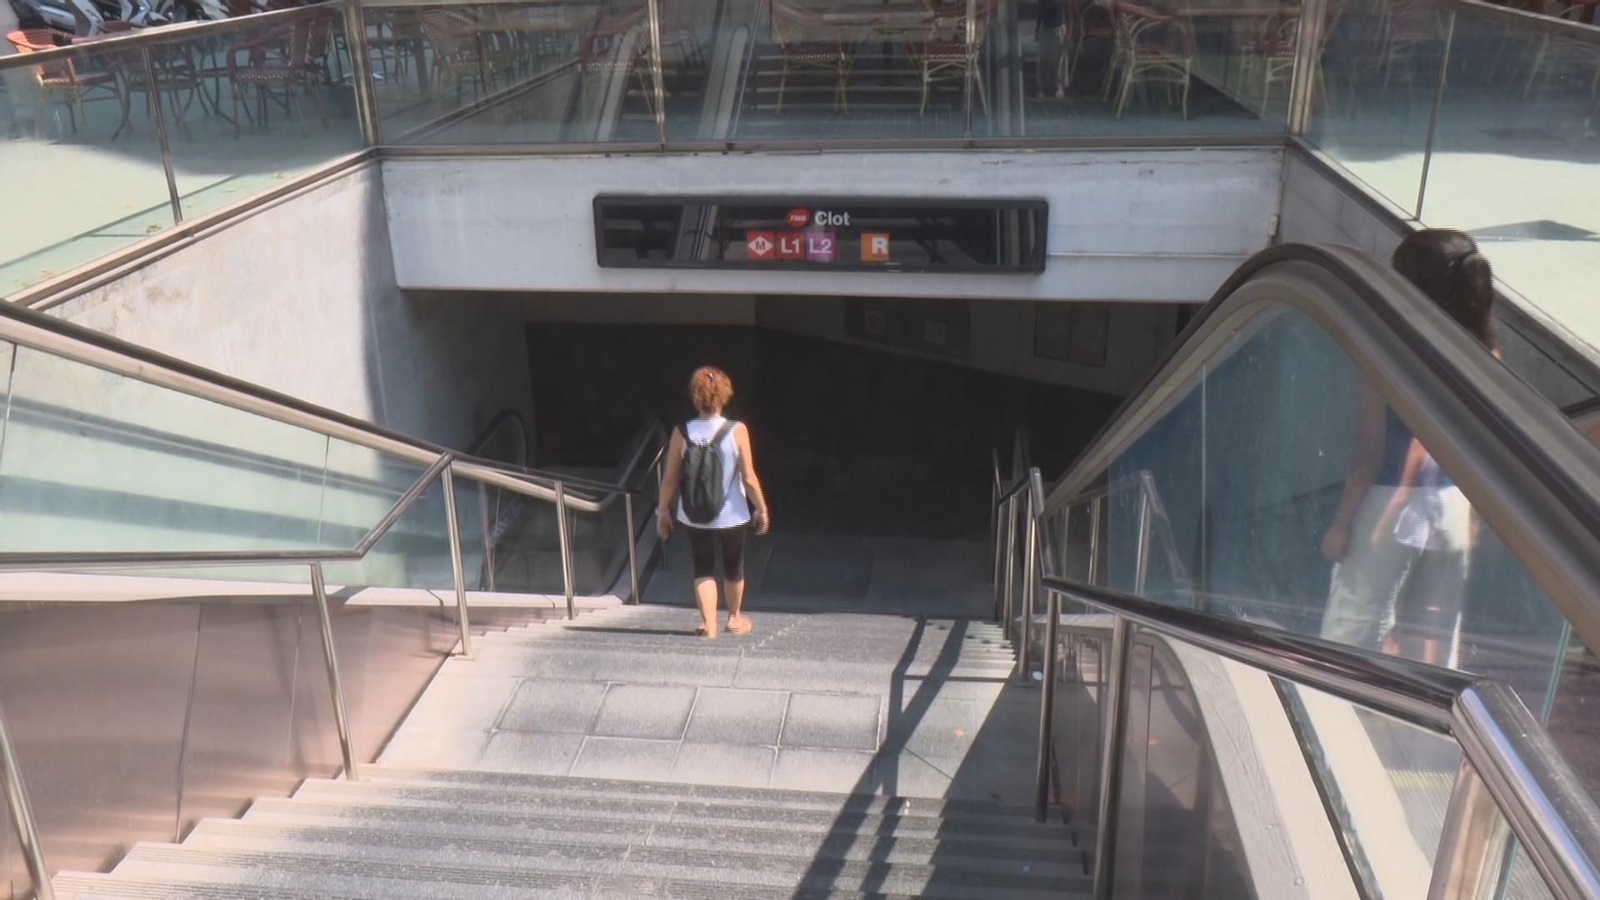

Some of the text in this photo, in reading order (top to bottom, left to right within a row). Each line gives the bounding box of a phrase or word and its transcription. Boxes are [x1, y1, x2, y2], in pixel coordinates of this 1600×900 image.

[814, 211, 850, 226] Clot
[781, 238, 800, 253] L1
[809, 239, 832, 253] L2
[871, 236, 888, 254] R
